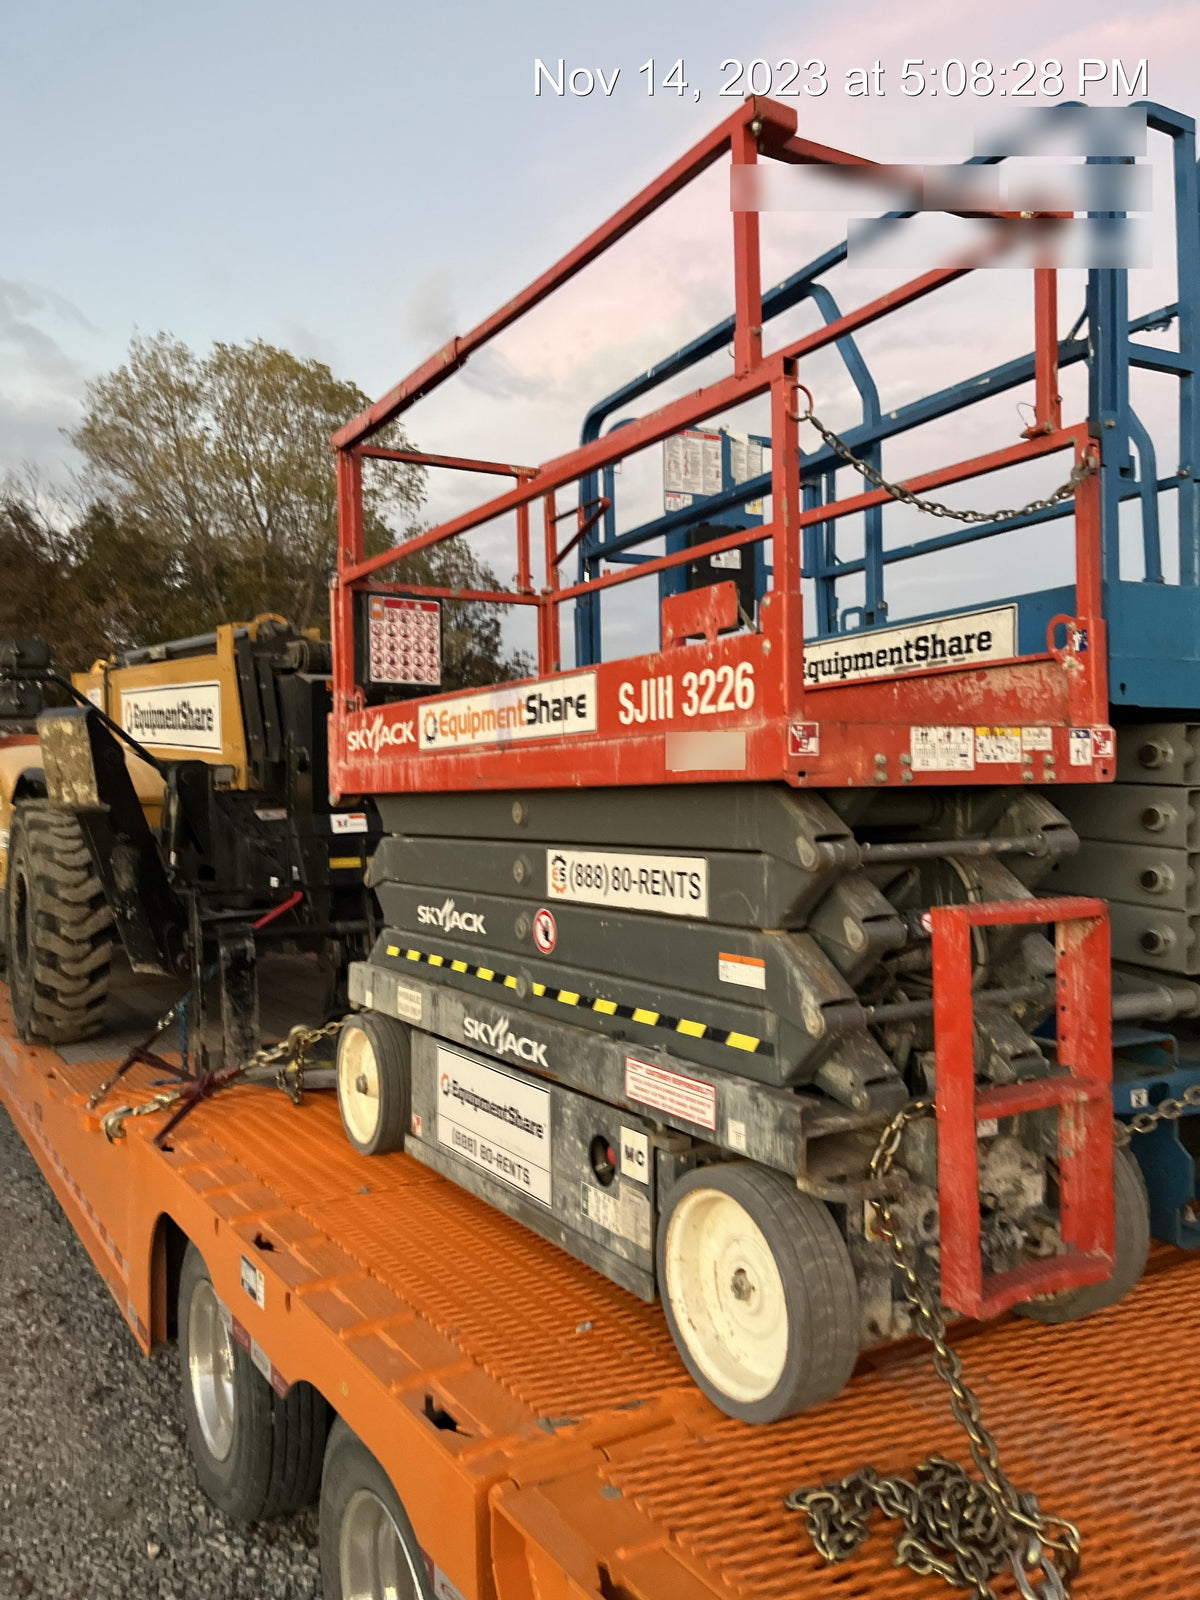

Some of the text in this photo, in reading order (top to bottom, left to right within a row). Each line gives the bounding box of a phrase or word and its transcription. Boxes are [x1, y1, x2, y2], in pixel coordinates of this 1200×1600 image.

[681, 661, 755, 717] 3226
[347, 712, 416, 753] SKYJACK
[438, 693, 588, 741] EquipmentShare
[417, 898, 487, 935] SKYJACK
[463, 1016, 549, 1067] SKYJACK
[452, 1079, 544, 1140] EquipmentShare
